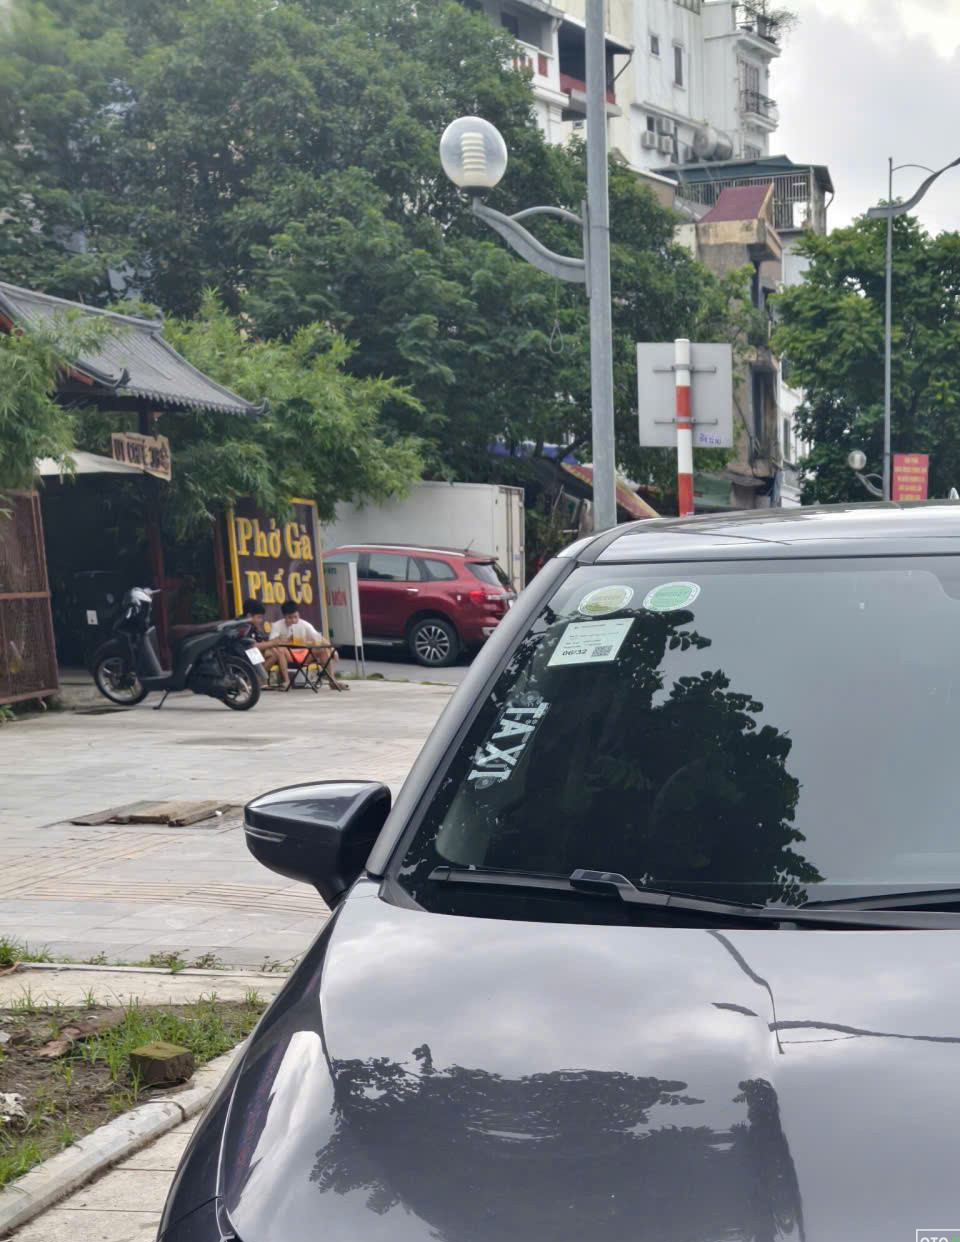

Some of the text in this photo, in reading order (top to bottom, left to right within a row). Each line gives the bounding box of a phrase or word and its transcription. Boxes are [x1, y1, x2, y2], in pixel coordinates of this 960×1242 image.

[236, 517, 314, 560] Phở Gà
[467, 702, 549, 780] TAXI
